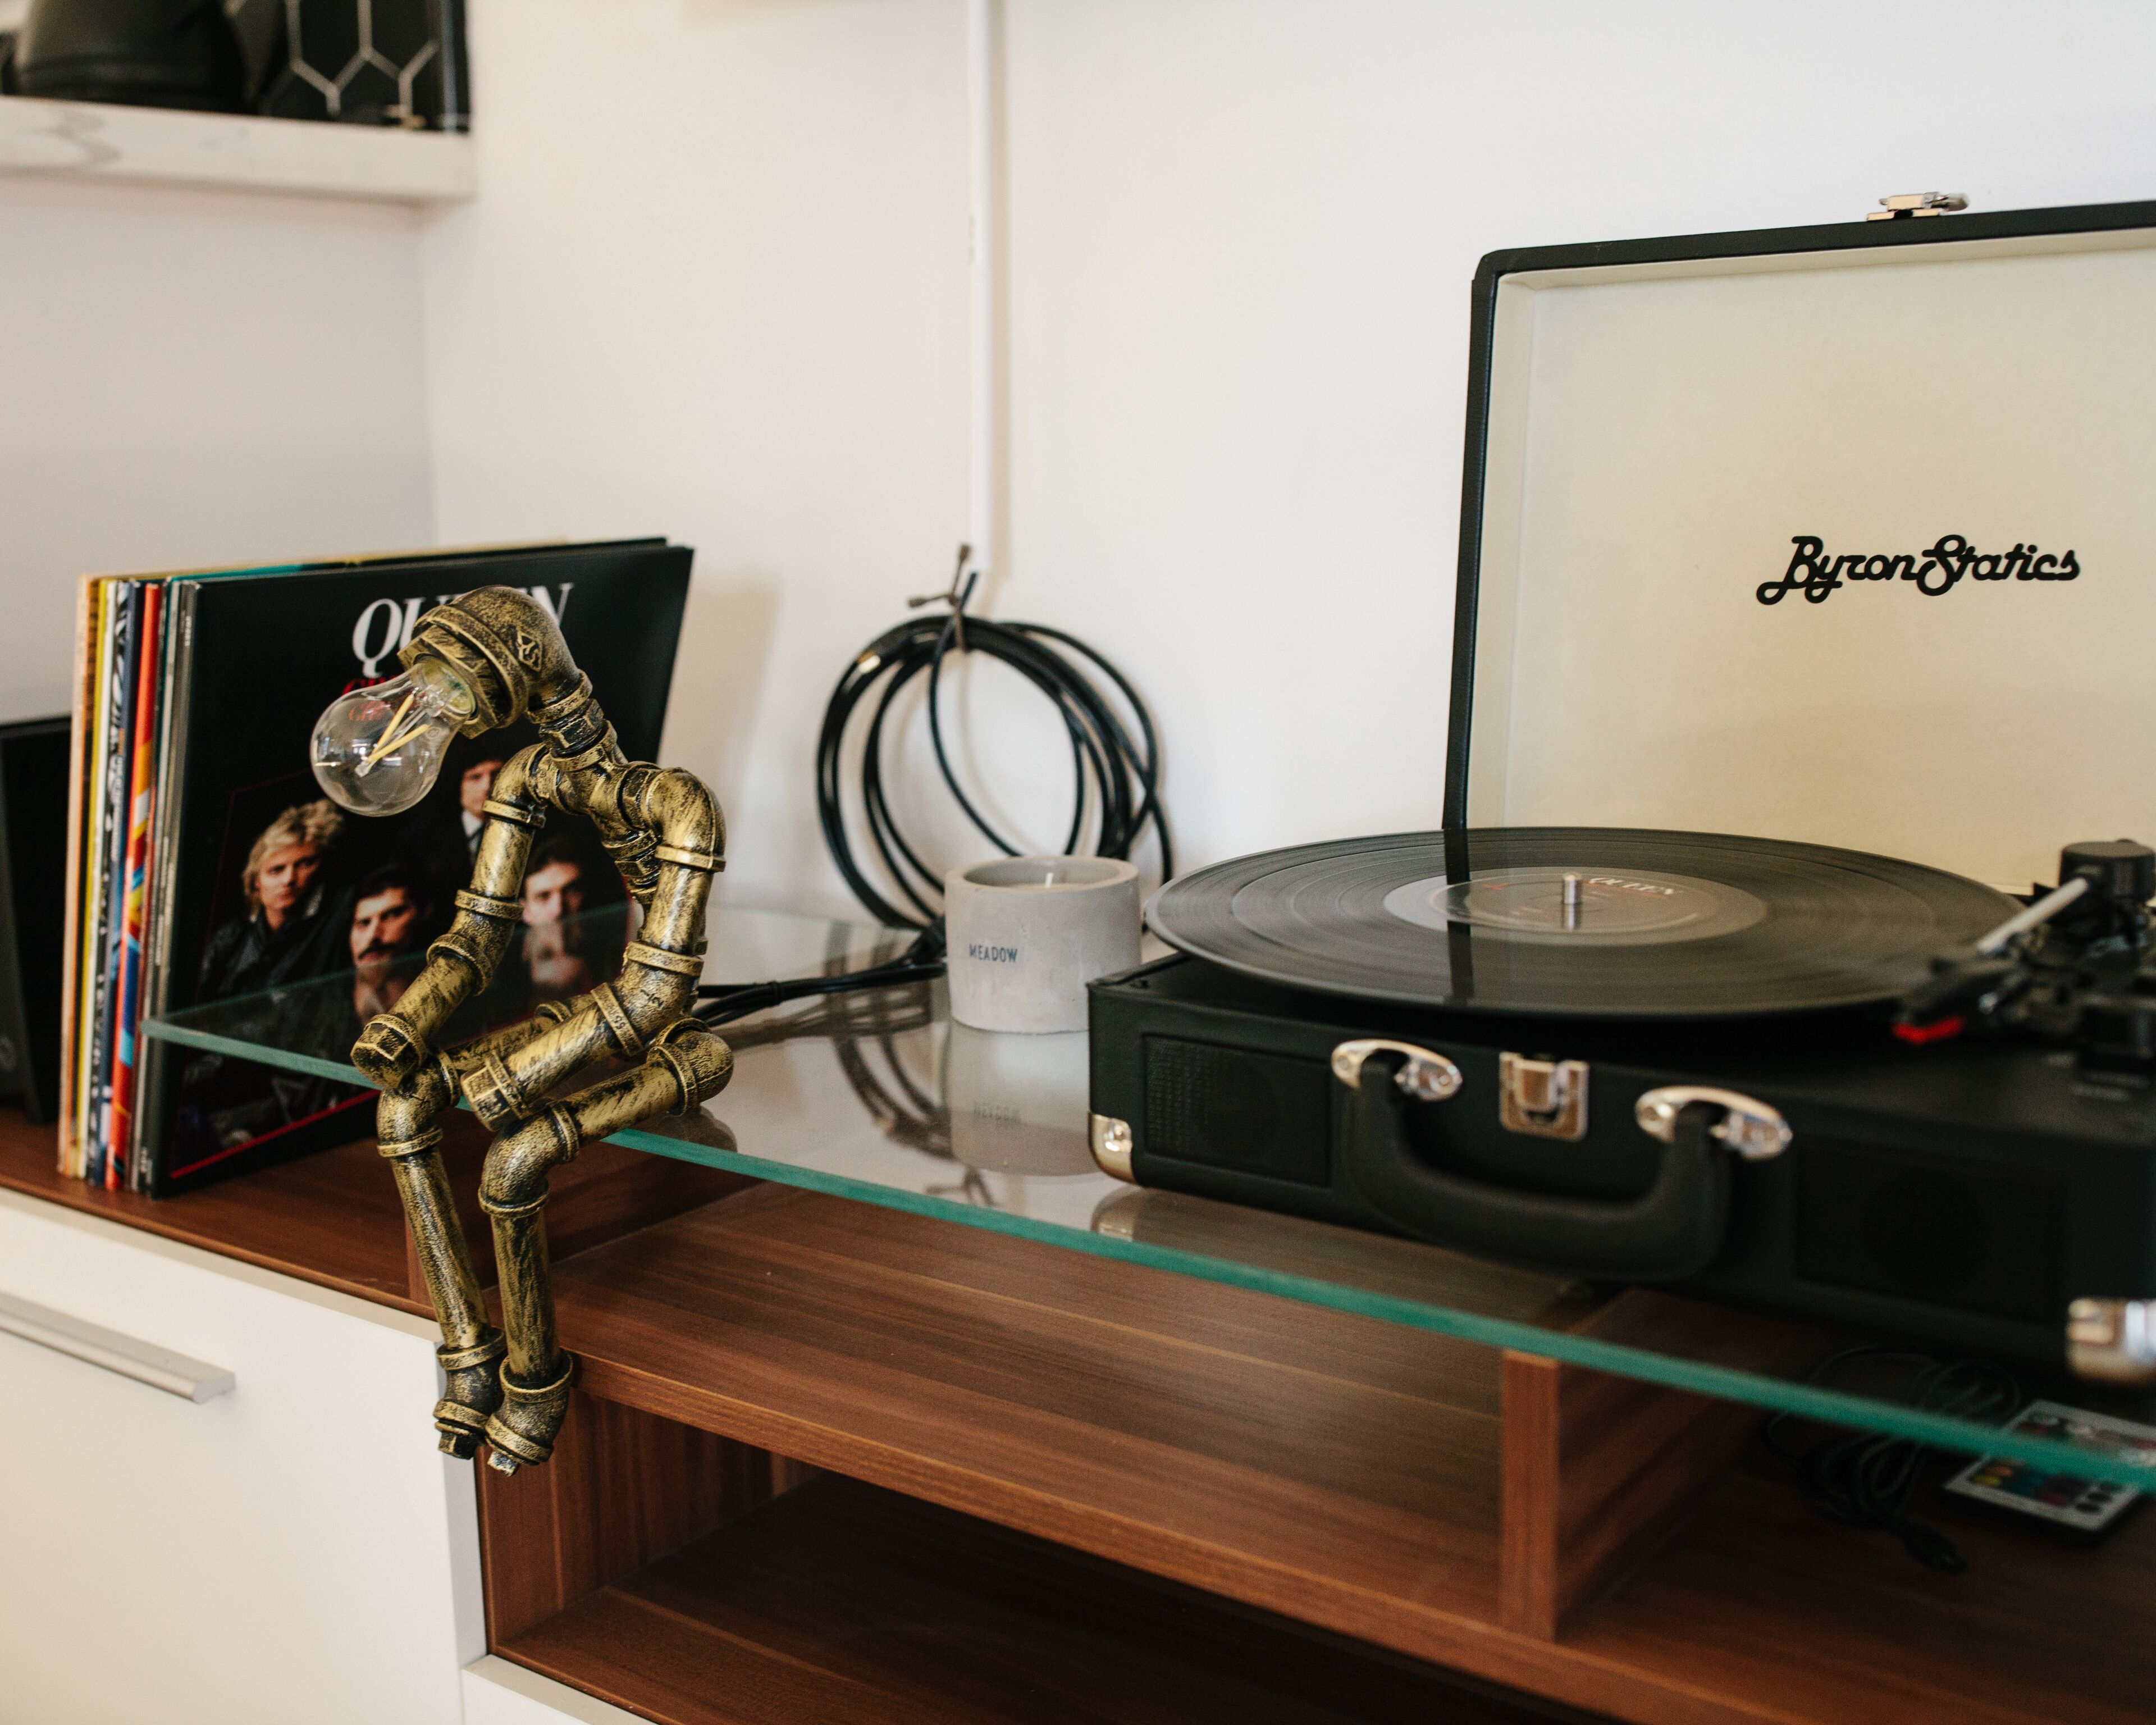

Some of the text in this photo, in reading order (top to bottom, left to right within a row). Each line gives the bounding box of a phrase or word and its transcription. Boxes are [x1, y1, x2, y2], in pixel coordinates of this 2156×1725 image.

[1756, 534, 2080, 605] ByronStatics
[352, 582, 574, 678] QUN
[969, 944, 1018, 963] MEADOW
